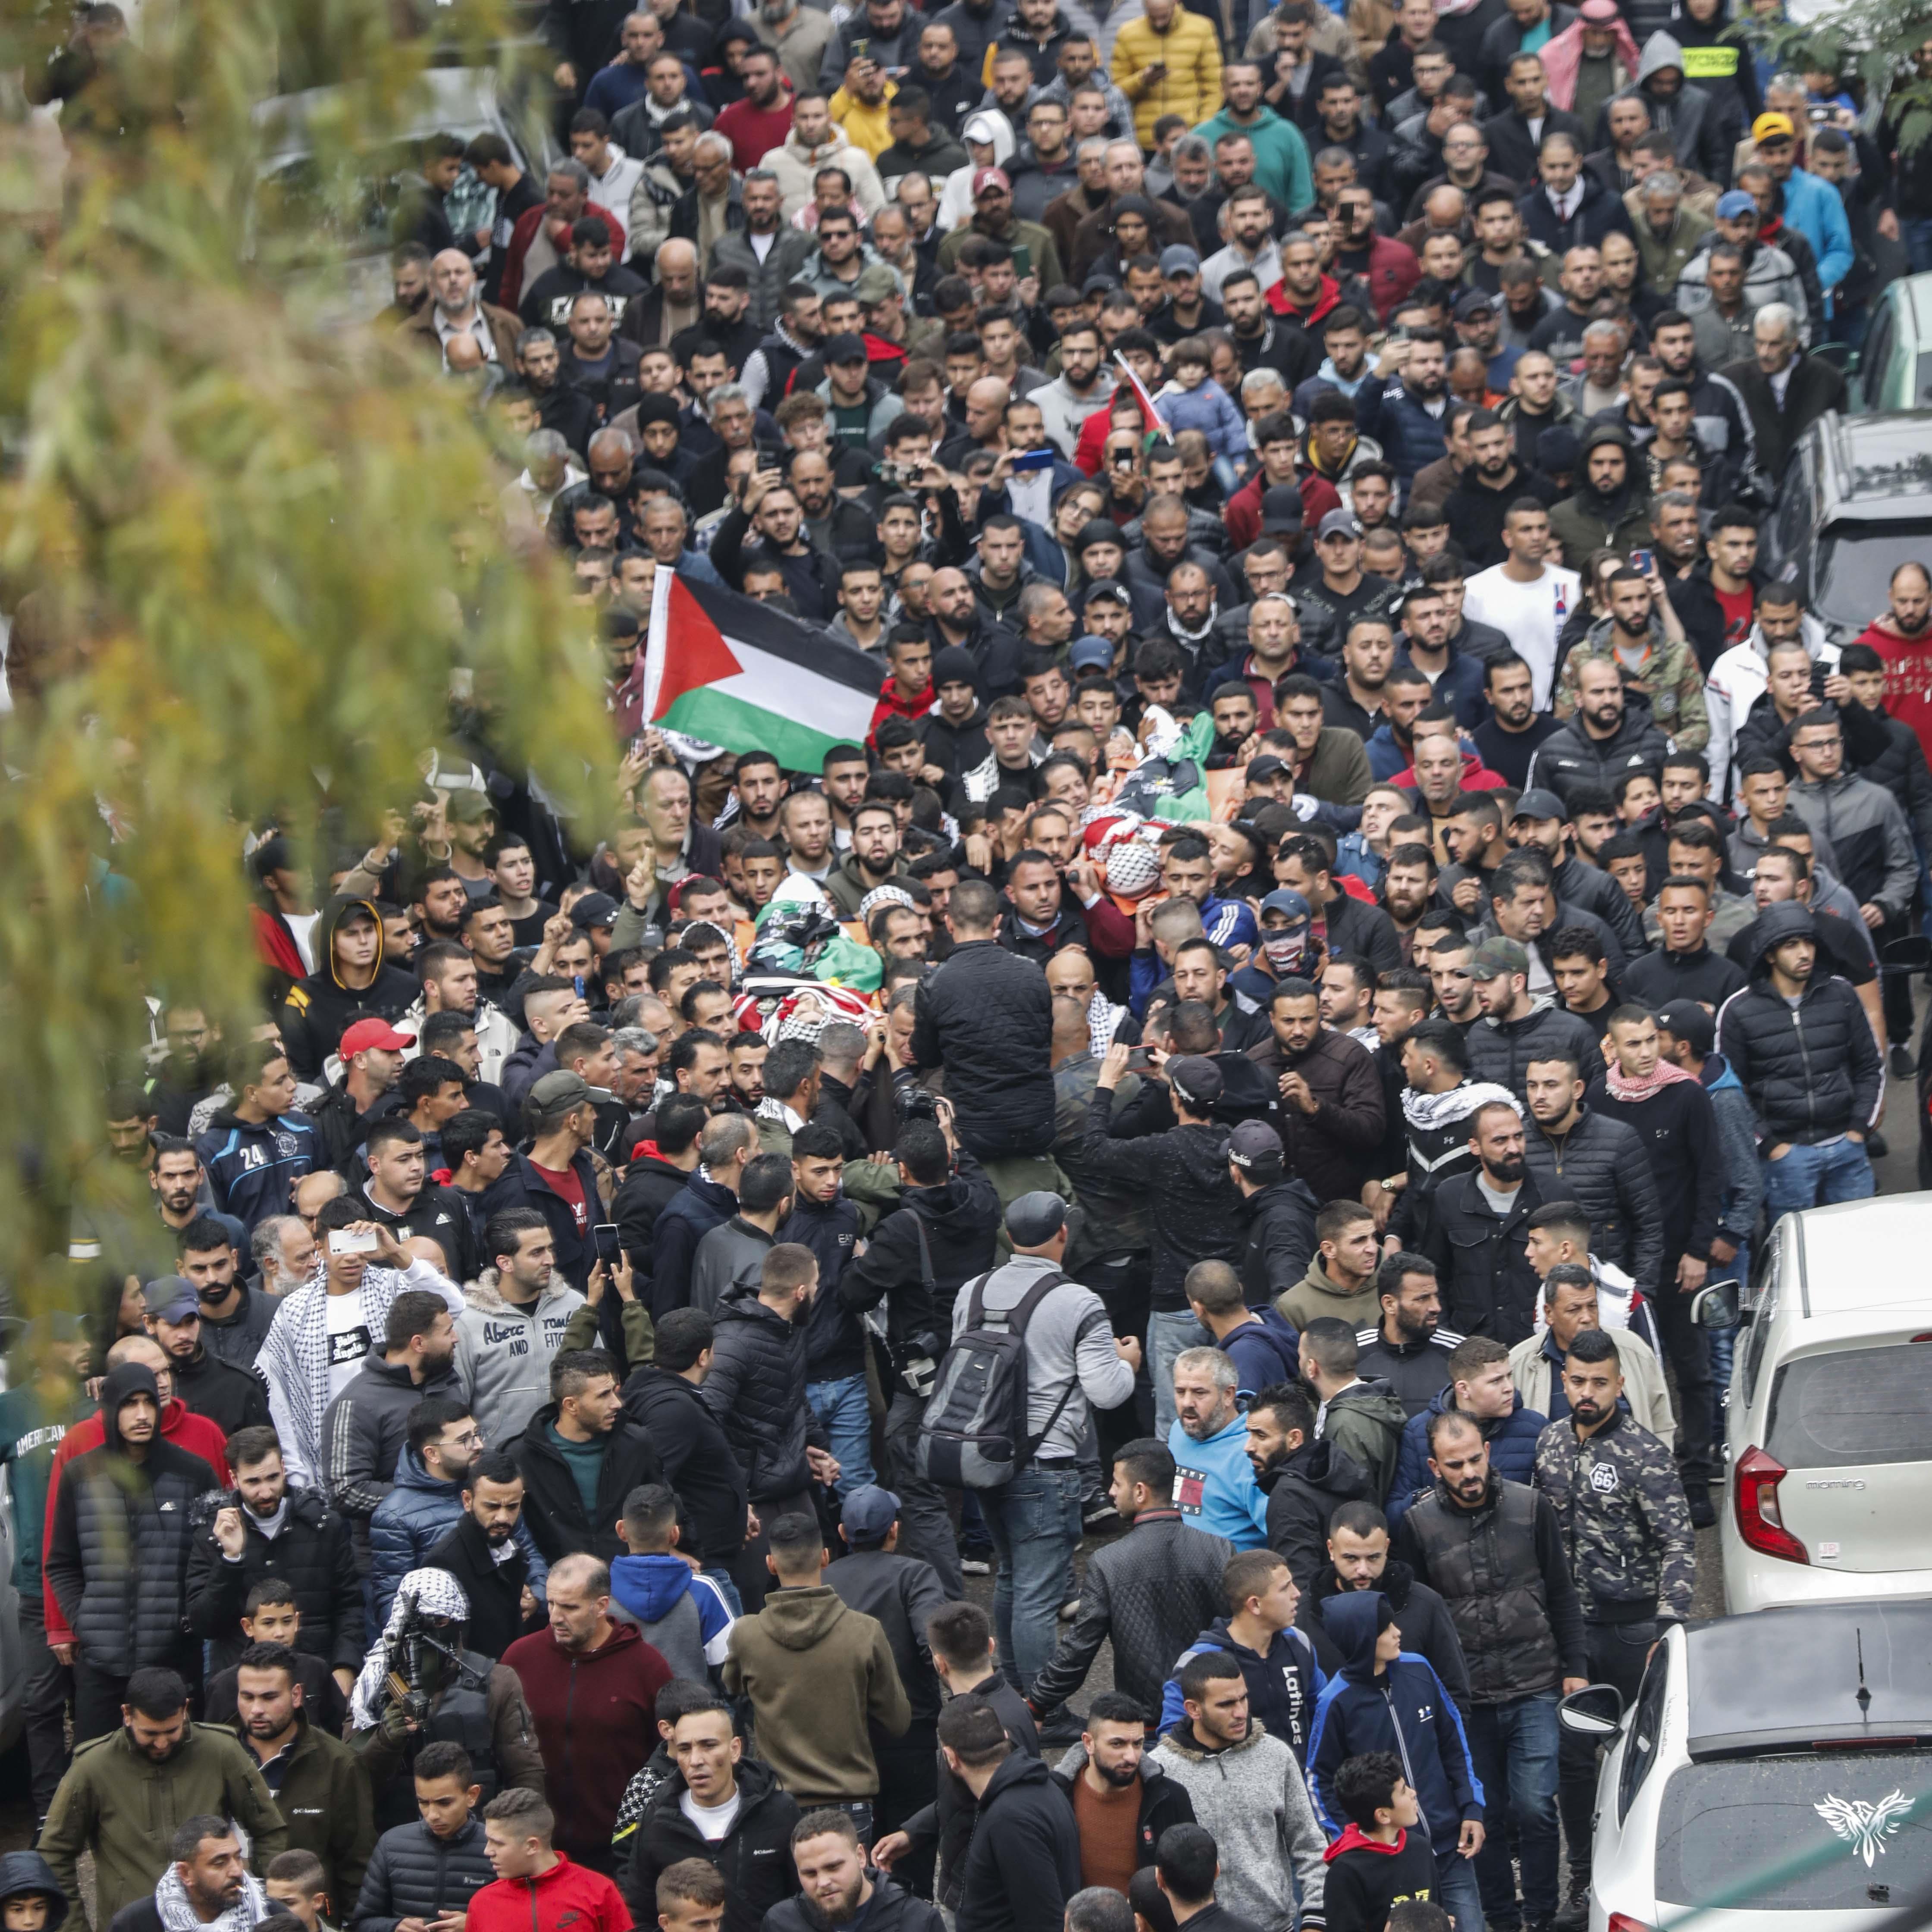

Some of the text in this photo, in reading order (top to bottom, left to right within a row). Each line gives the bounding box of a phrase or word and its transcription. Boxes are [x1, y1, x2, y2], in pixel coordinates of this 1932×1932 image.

[239, 1144, 264, 1170] 24
[510, 1332, 565, 1357] AND FITC
[1594, 1471, 1612, 1488] 66
[1806, 1477, 1865, 1490] morning
